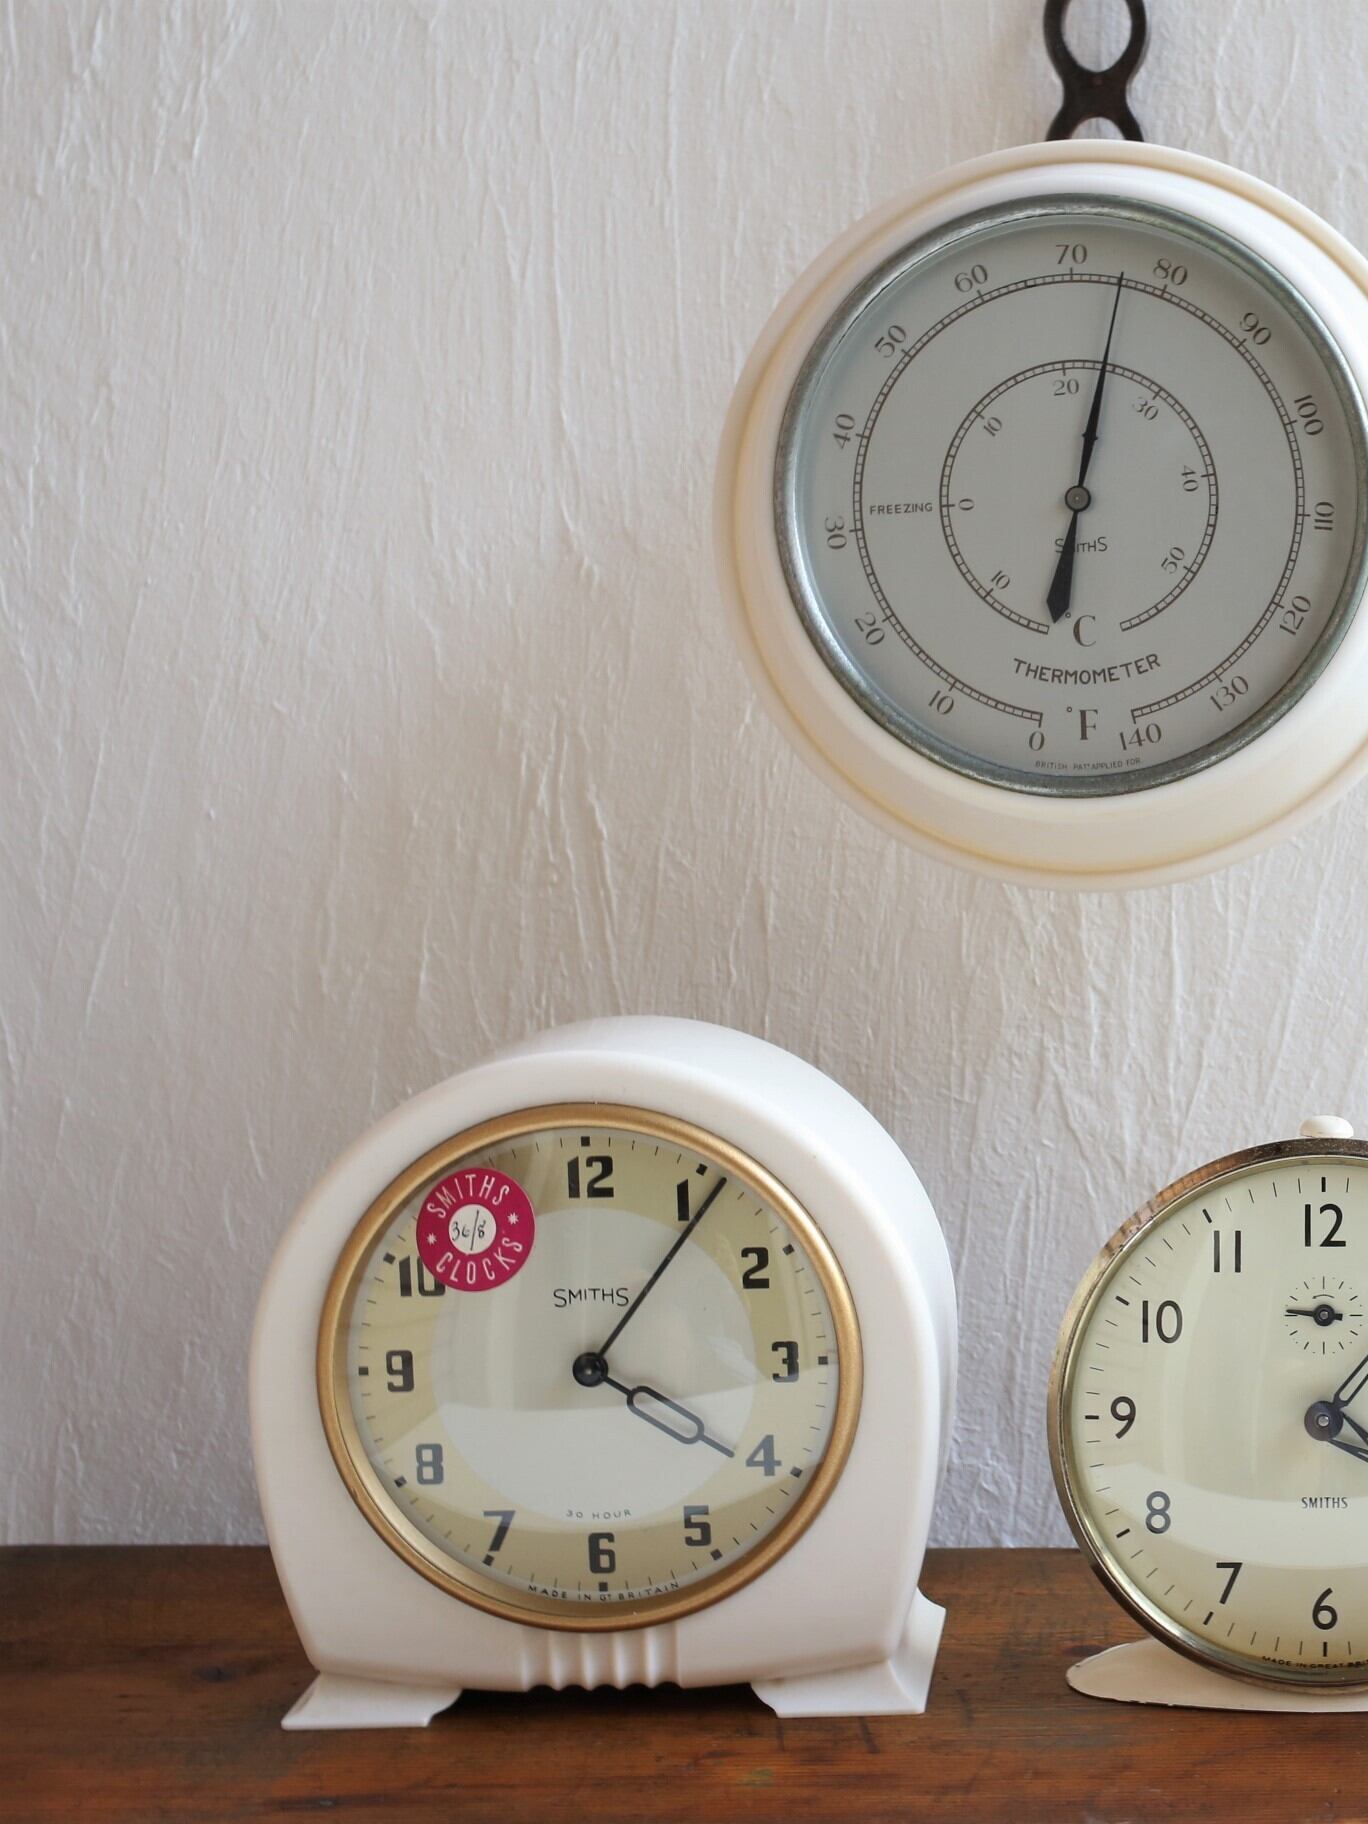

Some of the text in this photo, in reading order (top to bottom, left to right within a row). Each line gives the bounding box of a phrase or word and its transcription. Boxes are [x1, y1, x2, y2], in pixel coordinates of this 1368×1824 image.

[1055, 244, 1087, 264] 70
[954, 264, 988, 293] 60
[1153, 258, 1188, 286] 80
[874, 325, 906, 358] 50
[1239, 312, 1271, 345] 90
[1053, 379, 1079, 396] 20
[1132, 396, 1159, 421] 30
[1294, 395, 1324, 436] 100
[832, 413, 855, 449] 40
[983, 417, 1003, 437] 10
[1180, 465, 1199, 492] 40
[869, 502, 933, 515] FREEZING
[959, 498, 975, 511] 0
[1314, 501, 1335, 531] 110
[824, 516, 848, 550] 30
[1054, 536, 1108, 554] SITHS
[1161, 546, 1185, 574] 50
[990, 570, 1011, 590] 10
[854, 612, 885, 646] 20
[1279, 595, 1311, 636] 120
[1013, 653, 1161, 685] THERMOMETER
[928, 690, 954, 716] 10
[1210, 675, 1249, 711] 130
[1028, 731, 1045, 751] 0
[1119, 723, 1162, 750] 140
[567, 1155, 614, 1198] 12
[427, 1174, 510, 1218] SMITHS
[676, 1179, 690, 1221] 1
[1304, 1203, 1346, 1247] 12
[436, 1237, 523, 1284] CLOCKS
[741, 1247, 769, 1289] 2
[1213, 1230, 1241, 1273] 11
[553, 1288, 629, 1308] SMITHS
[1142, 1300, 1183, 1343] 10
[386, 1350, 414, 1392] 9
[772, 1341, 799, 1383] 3
[1110, 1396, 1136, 1439] 9
[415, 1443, 444, 1485] 8
[745, 1434, 782, 1476] 4
[566, 1509, 632, 1520] 30 HOUR
[1145, 1491, 1171, 1534] 8
[1301, 1497, 1348, 1509] SMITHS
[483, 1510, 516, 1552] 7
[683, 1505, 711, 1547] 5
[588, 1532, 616, 1574] 6
[528, 1584, 568, 1599] MADE
[618, 1581, 679, 1600] BRITAIN
[1216, 1562, 1243, 1605] 7
[1312, 1587, 1338, 1630] 6
[1262, 1655, 1292, 1667] MADE
